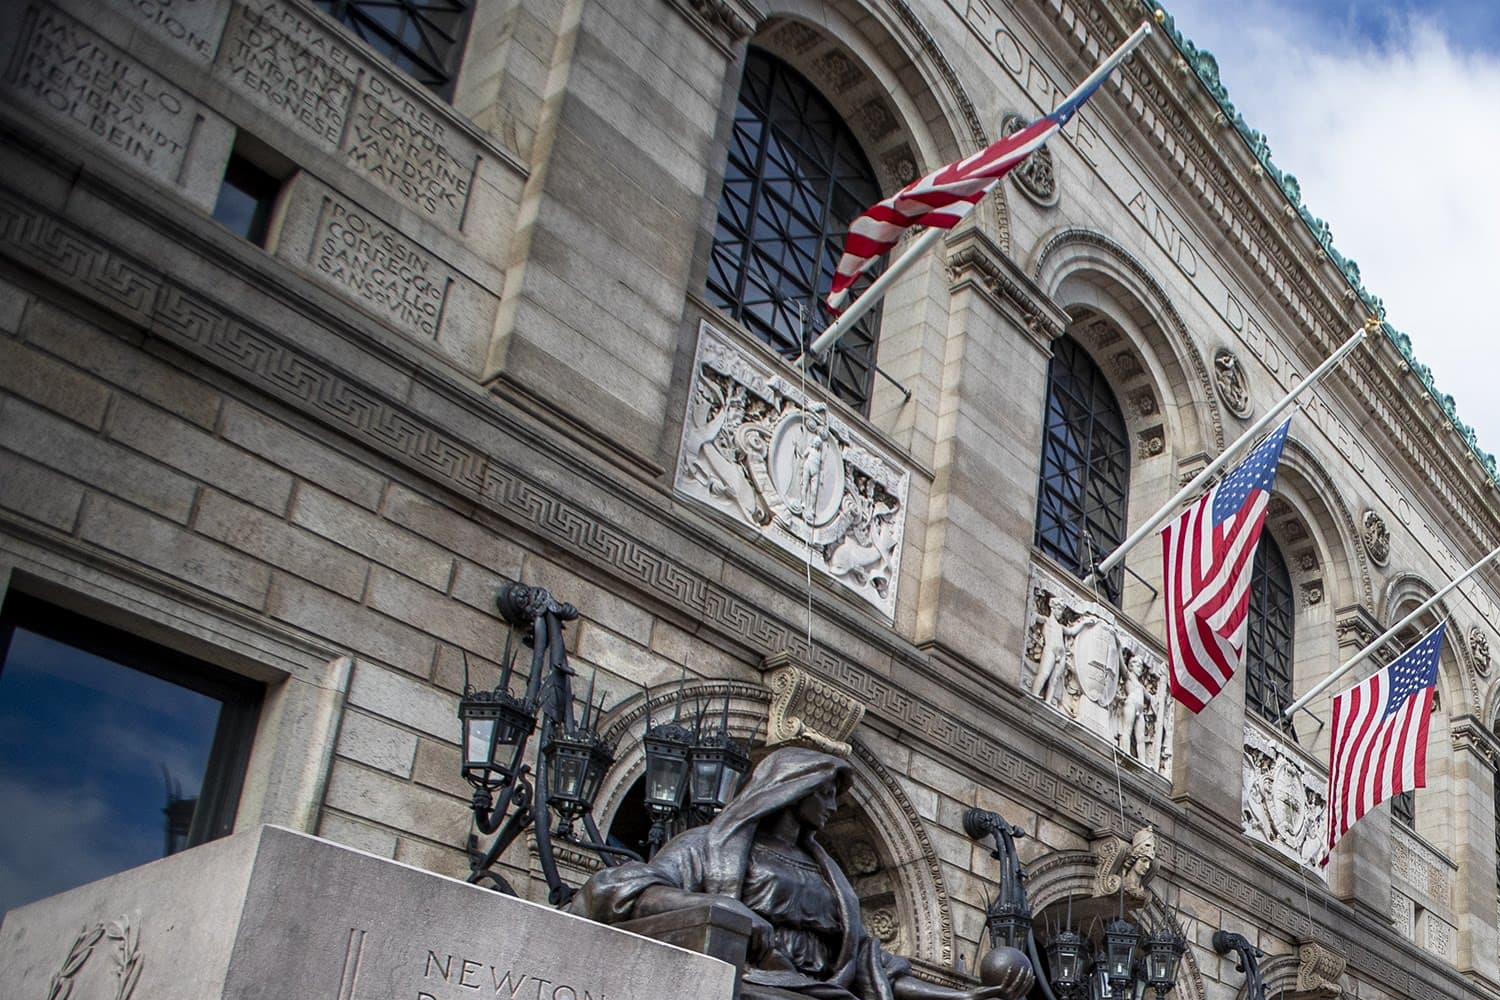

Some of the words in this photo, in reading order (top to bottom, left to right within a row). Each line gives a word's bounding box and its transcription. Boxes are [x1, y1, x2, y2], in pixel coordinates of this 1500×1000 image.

[34, 33, 144, 114] RVBENS
[40, 17, 181, 114] MVRILLO
[256, 0, 355, 74] APHAEL
[22, 70, 154, 163] HOLBEIN
[27, 52, 183, 154] REMBRANDT
[228, 56, 337, 145] VERONESE
[234, 37, 341, 126] TINTORETTO
[369, 76, 444, 138] DVRER
[965, 0, 1097, 168] EOPLE
[1127, 190, 1198, 279] AND
[347, 146, 437, 215] MATSYS
[328, 222, 441, 300] CORREGGIO
[333, 202, 429, 273] POVSSIN
[318, 255, 433, 335] SANSOVINO
